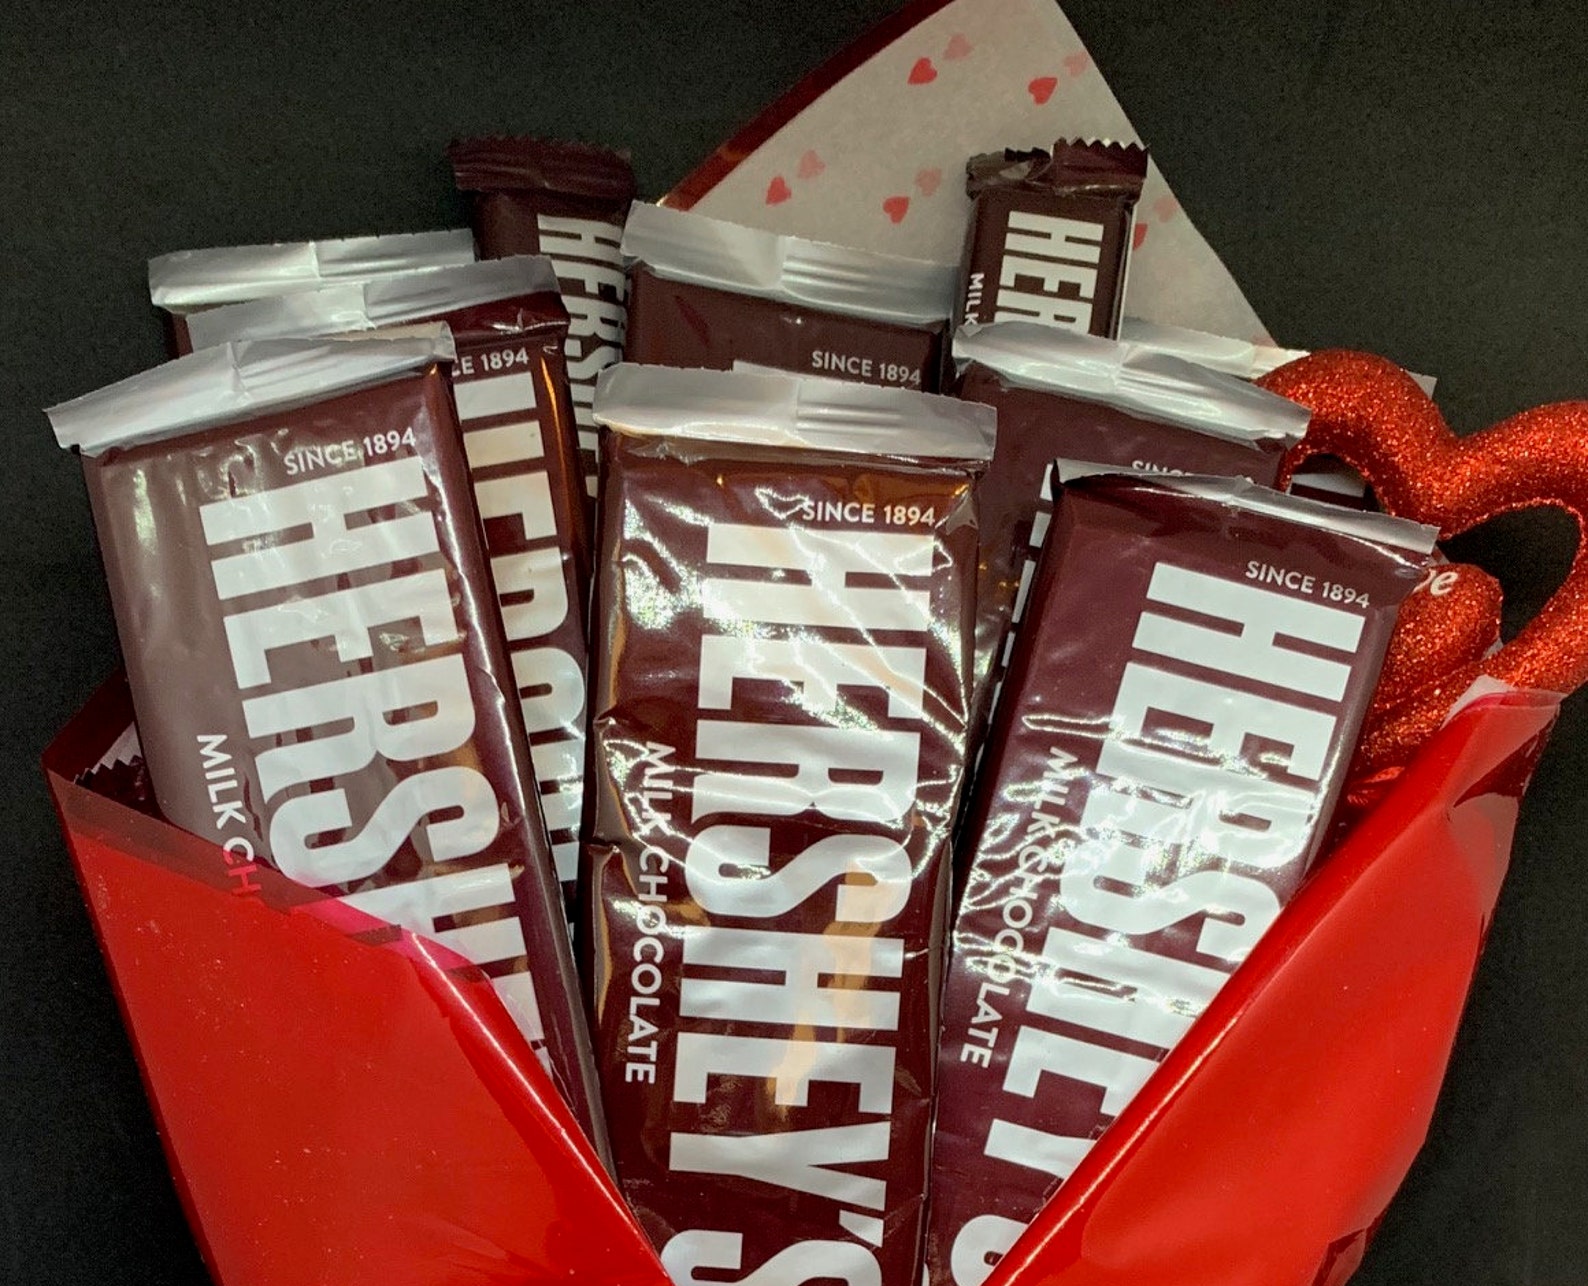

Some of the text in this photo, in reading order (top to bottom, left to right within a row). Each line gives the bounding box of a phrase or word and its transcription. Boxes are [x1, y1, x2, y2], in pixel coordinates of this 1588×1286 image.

[964, 273, 984, 326] MILK
[481, 347, 529, 371] 1894
[811, 351, 921, 385] SINCE 1894
[284, 427, 416, 475] SINCE 1894
[801, 501, 936, 527] SINCE 1894
[1245, 561, 1370, 609] SINCE 1894
[196, 734, 246, 830] MILK
[1027, 746, 1078, 838] MILK
[625, 741, 676, 1084] MILK CHOCOLATE
[960, 845, 1048, 1068] CHOCOLATE
